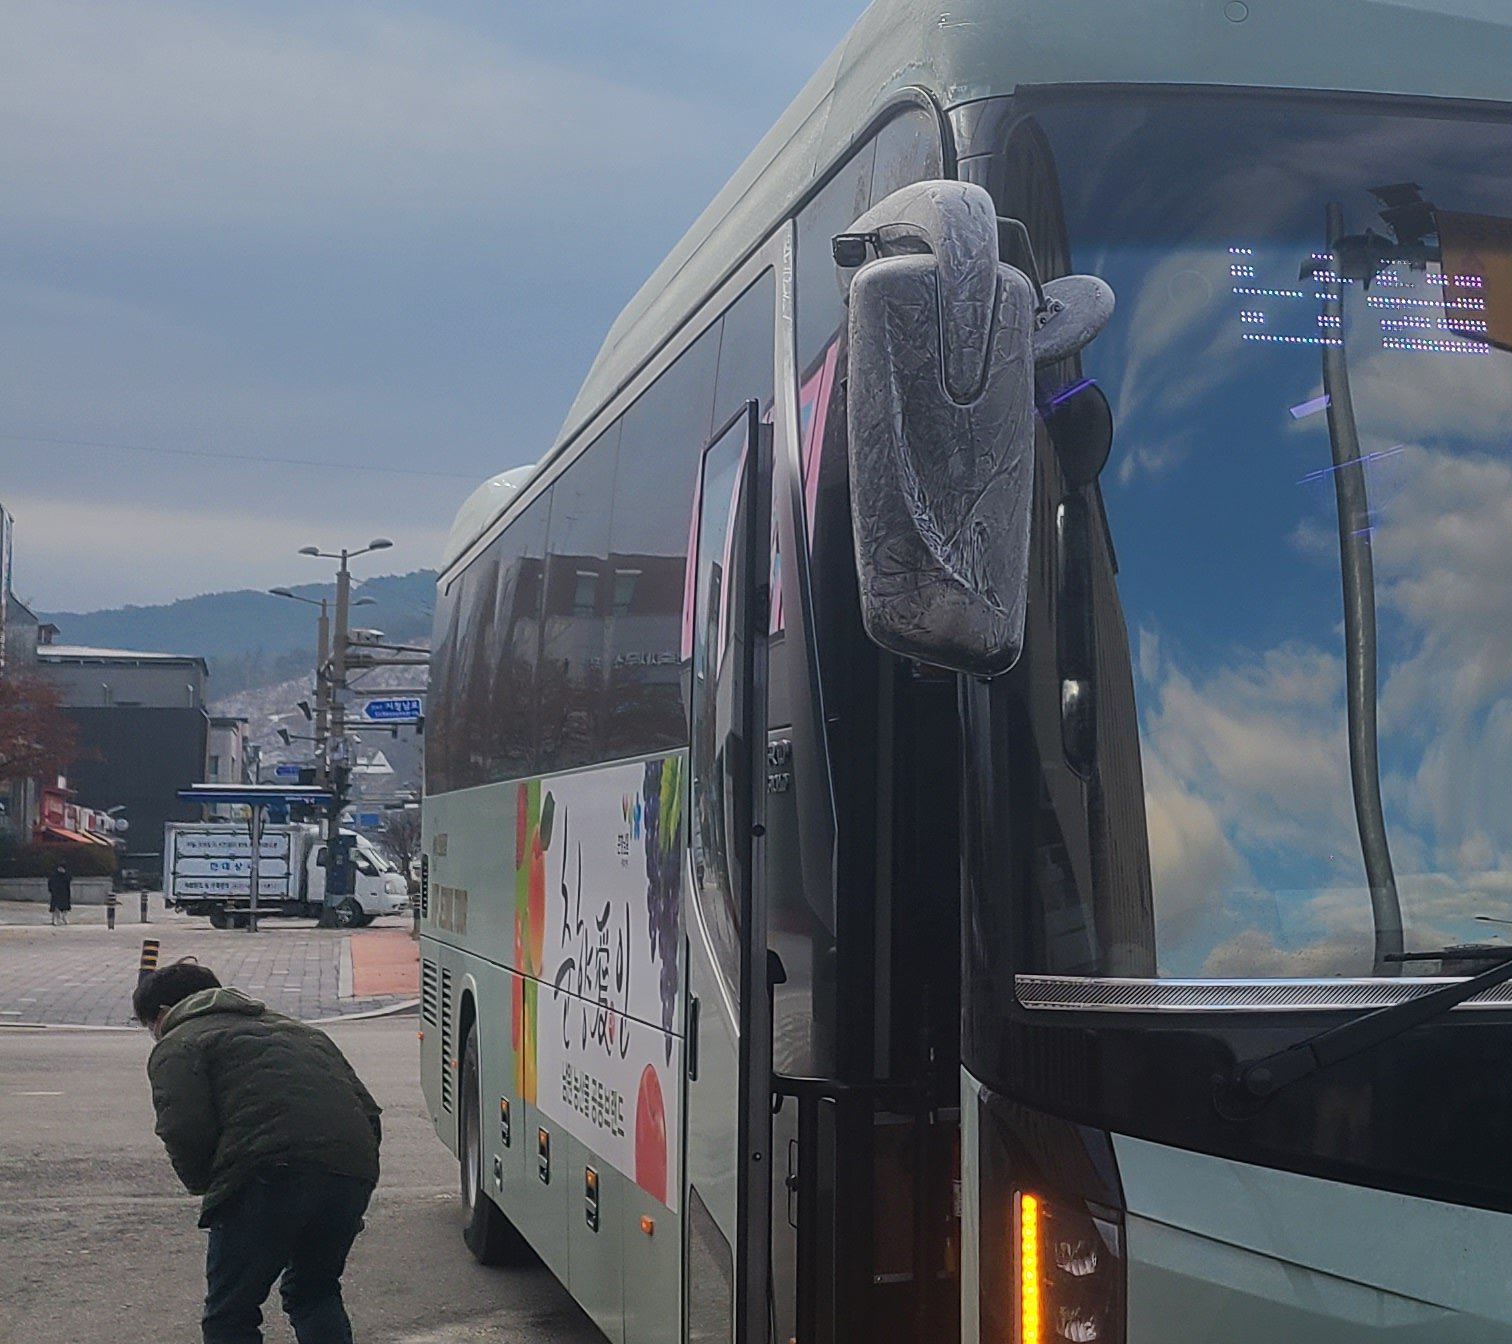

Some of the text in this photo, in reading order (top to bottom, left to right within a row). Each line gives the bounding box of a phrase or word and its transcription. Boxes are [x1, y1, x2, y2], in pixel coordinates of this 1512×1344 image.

[562, 1061, 625, 1138] 남원 농산물 공동브랜드
